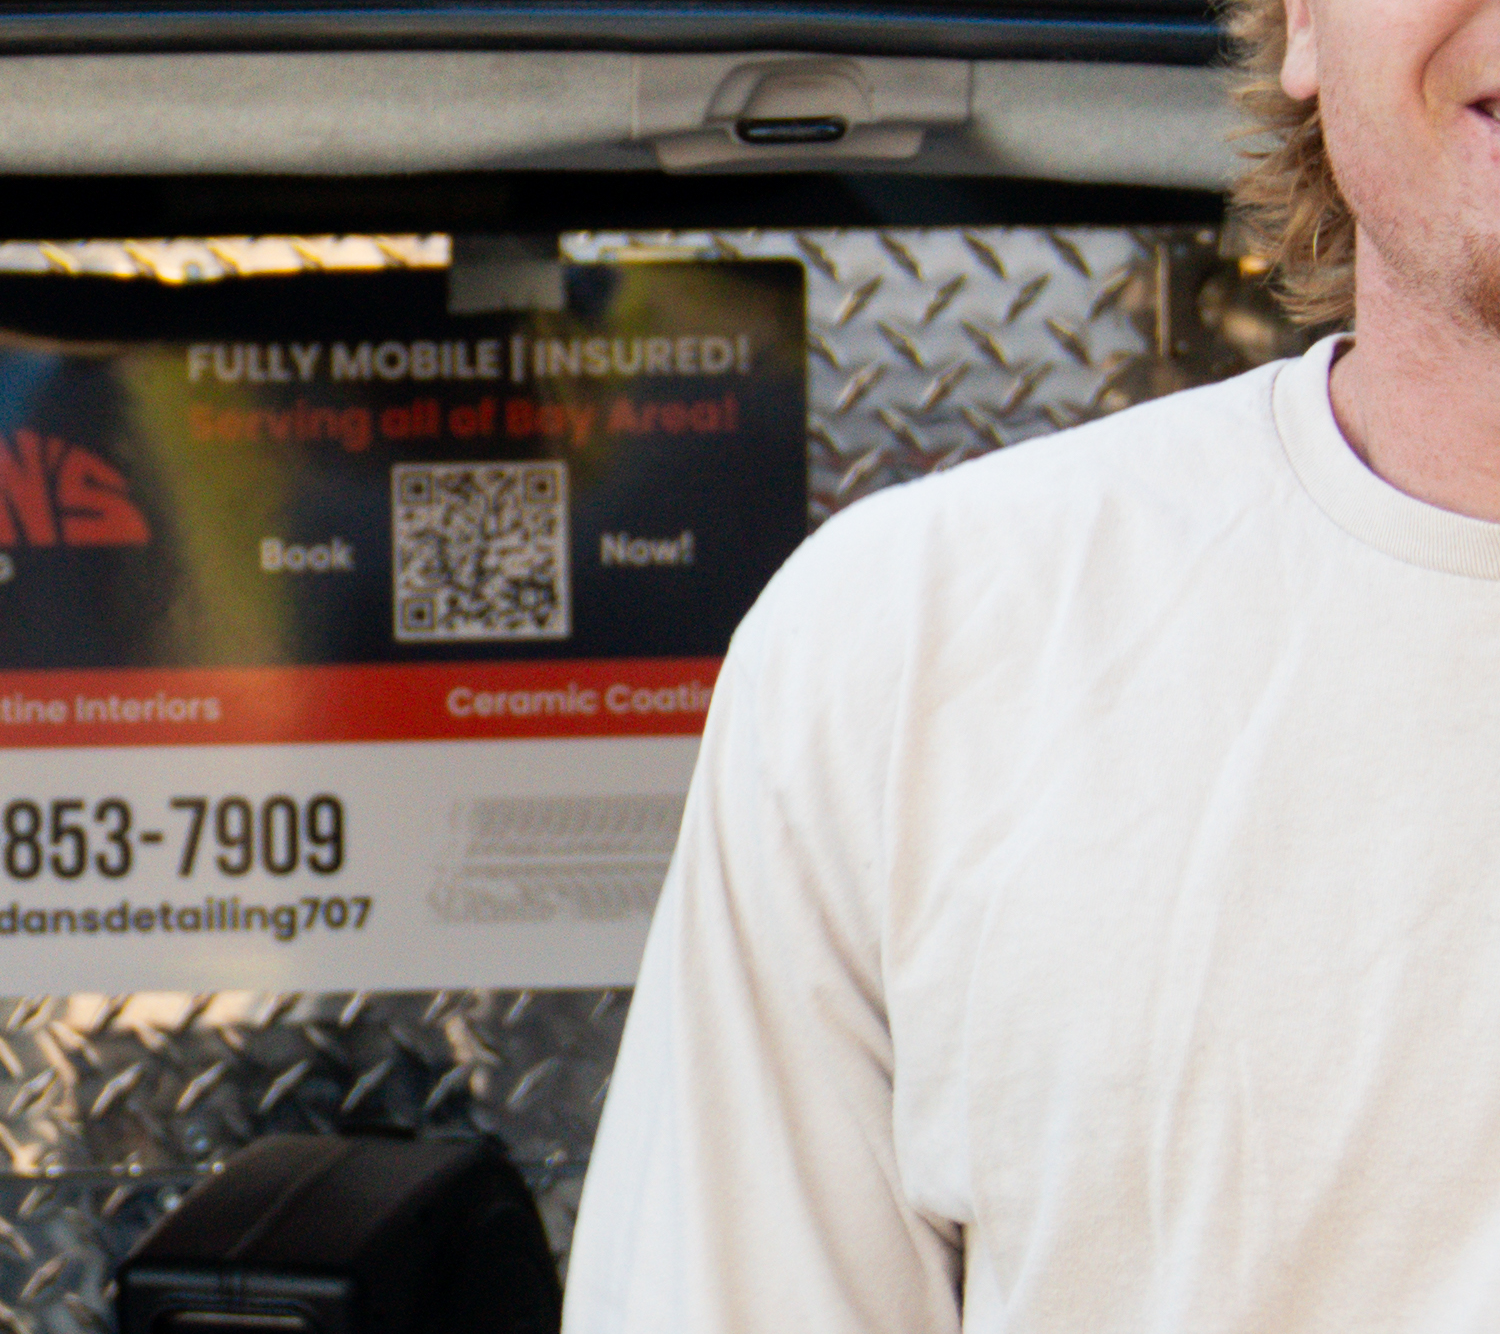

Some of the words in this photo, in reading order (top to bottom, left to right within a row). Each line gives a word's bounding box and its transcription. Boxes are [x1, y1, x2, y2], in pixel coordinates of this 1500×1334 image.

[188, 343, 321, 384] FULLY
[330, 338, 501, 381] MOBILE
[534, 333, 752, 377] INSURED!
[189, 397, 374, 453] Serving
[379, 397, 440, 439] all
[448, 396, 497, 438] of
[505, 400, 595, 449] Bay
[605, 393, 741, 435] Area!
[259, 536, 355, 572] Book
[599, 531, 696, 567] Now!
[75, 691, 222, 724] Interiors
[446, 680, 600, 717] Ceramic
